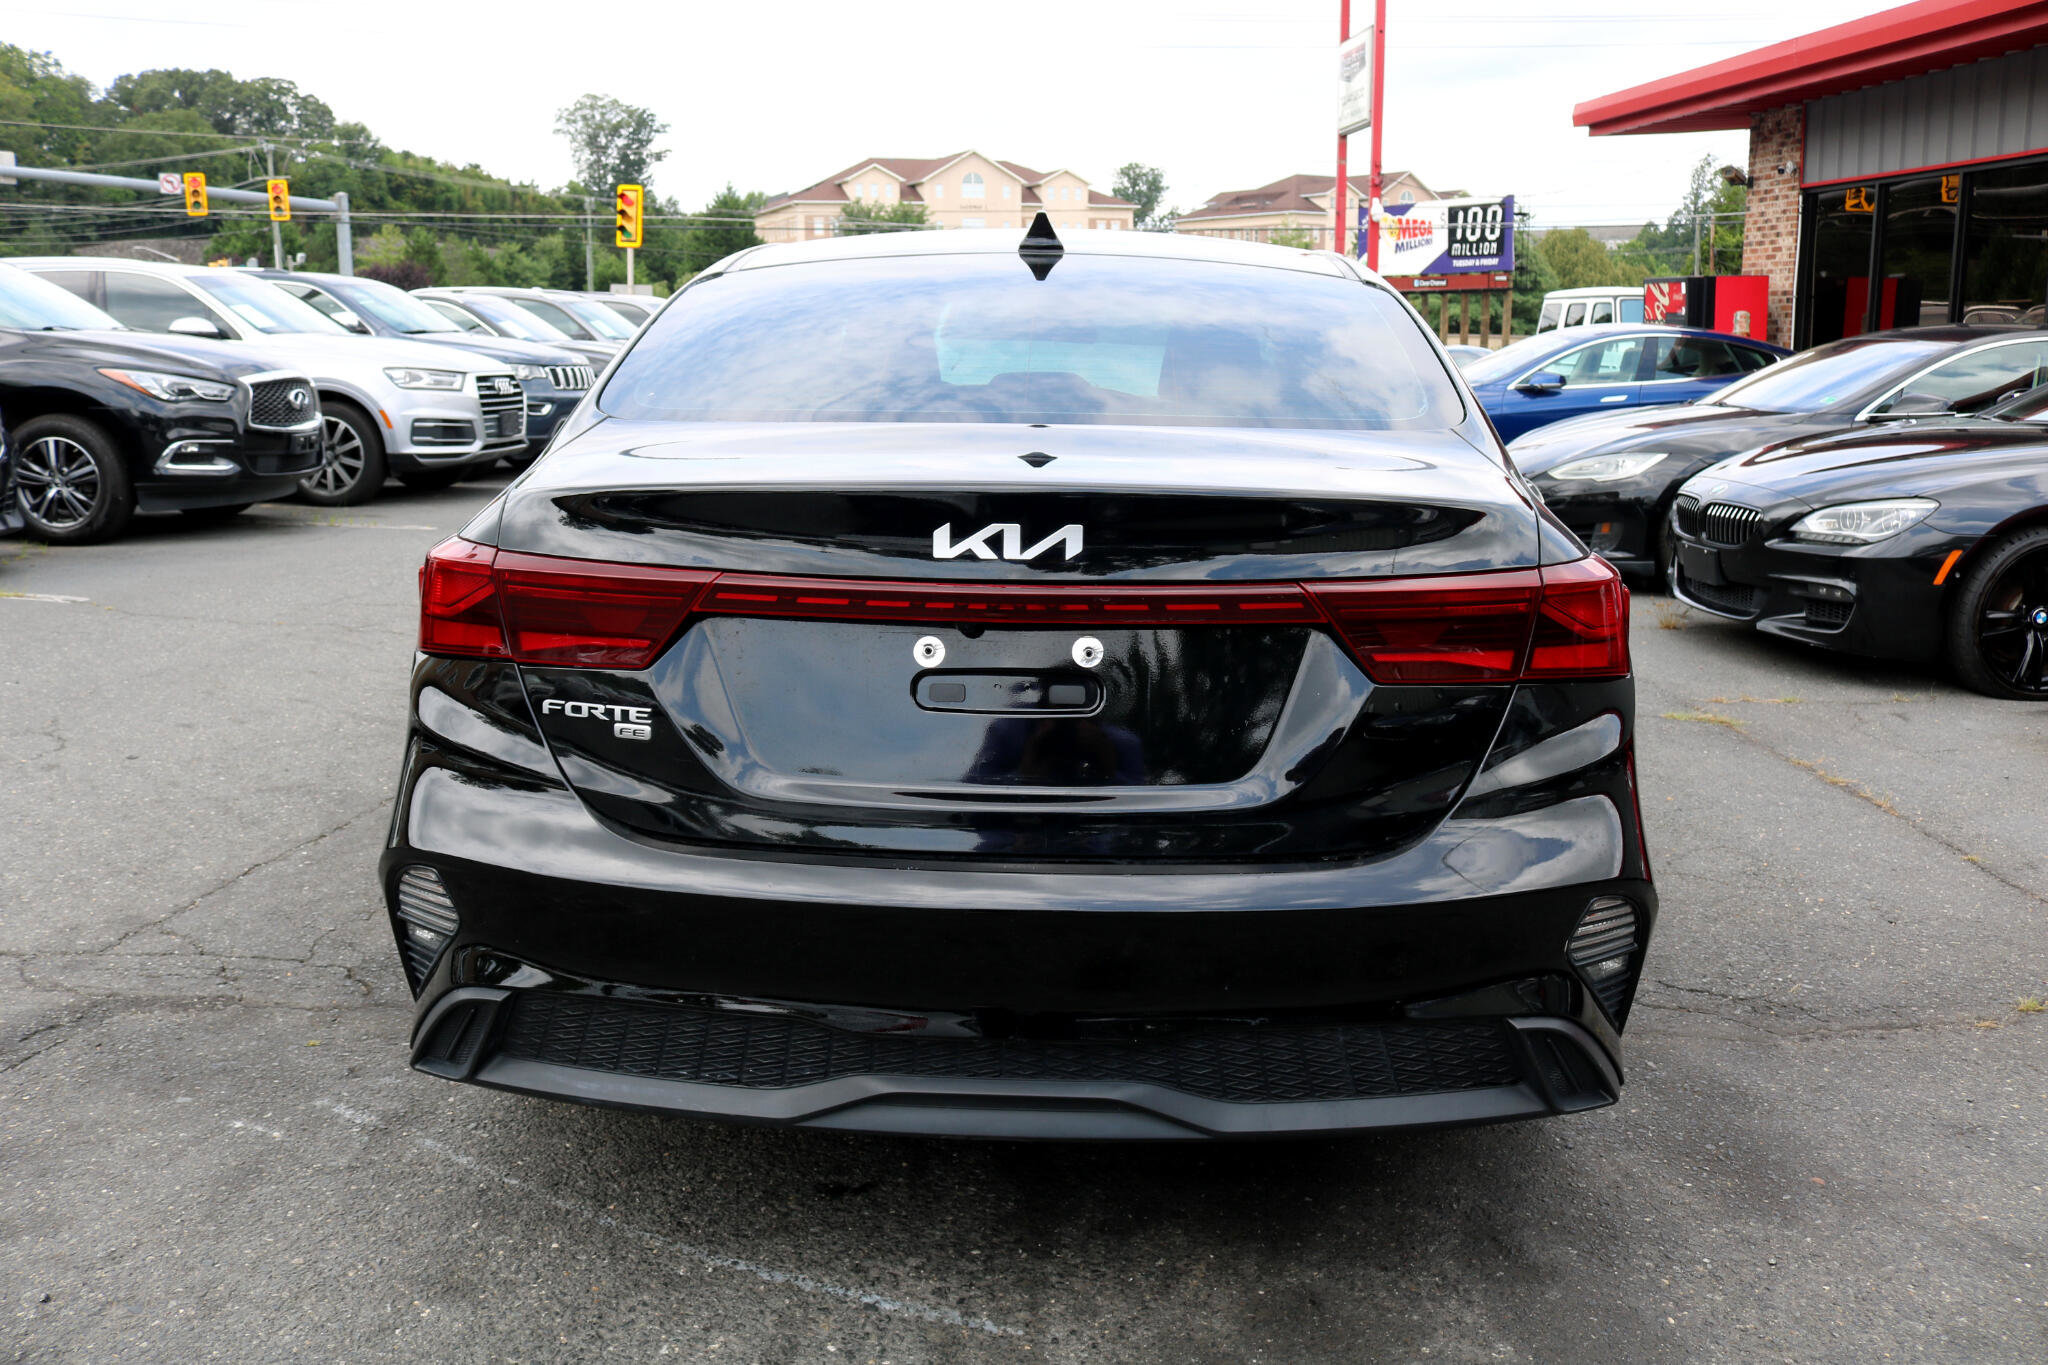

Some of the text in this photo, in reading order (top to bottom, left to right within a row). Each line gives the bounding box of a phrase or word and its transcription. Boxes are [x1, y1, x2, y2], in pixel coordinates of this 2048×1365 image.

[1396, 216, 1433, 240] MEGA
[1456, 204, 1503, 242] 100
[1451, 242, 1498, 256] MILLION
[933, 522, 1083, 561] KIA
[542, 699, 652, 724] FORTE
